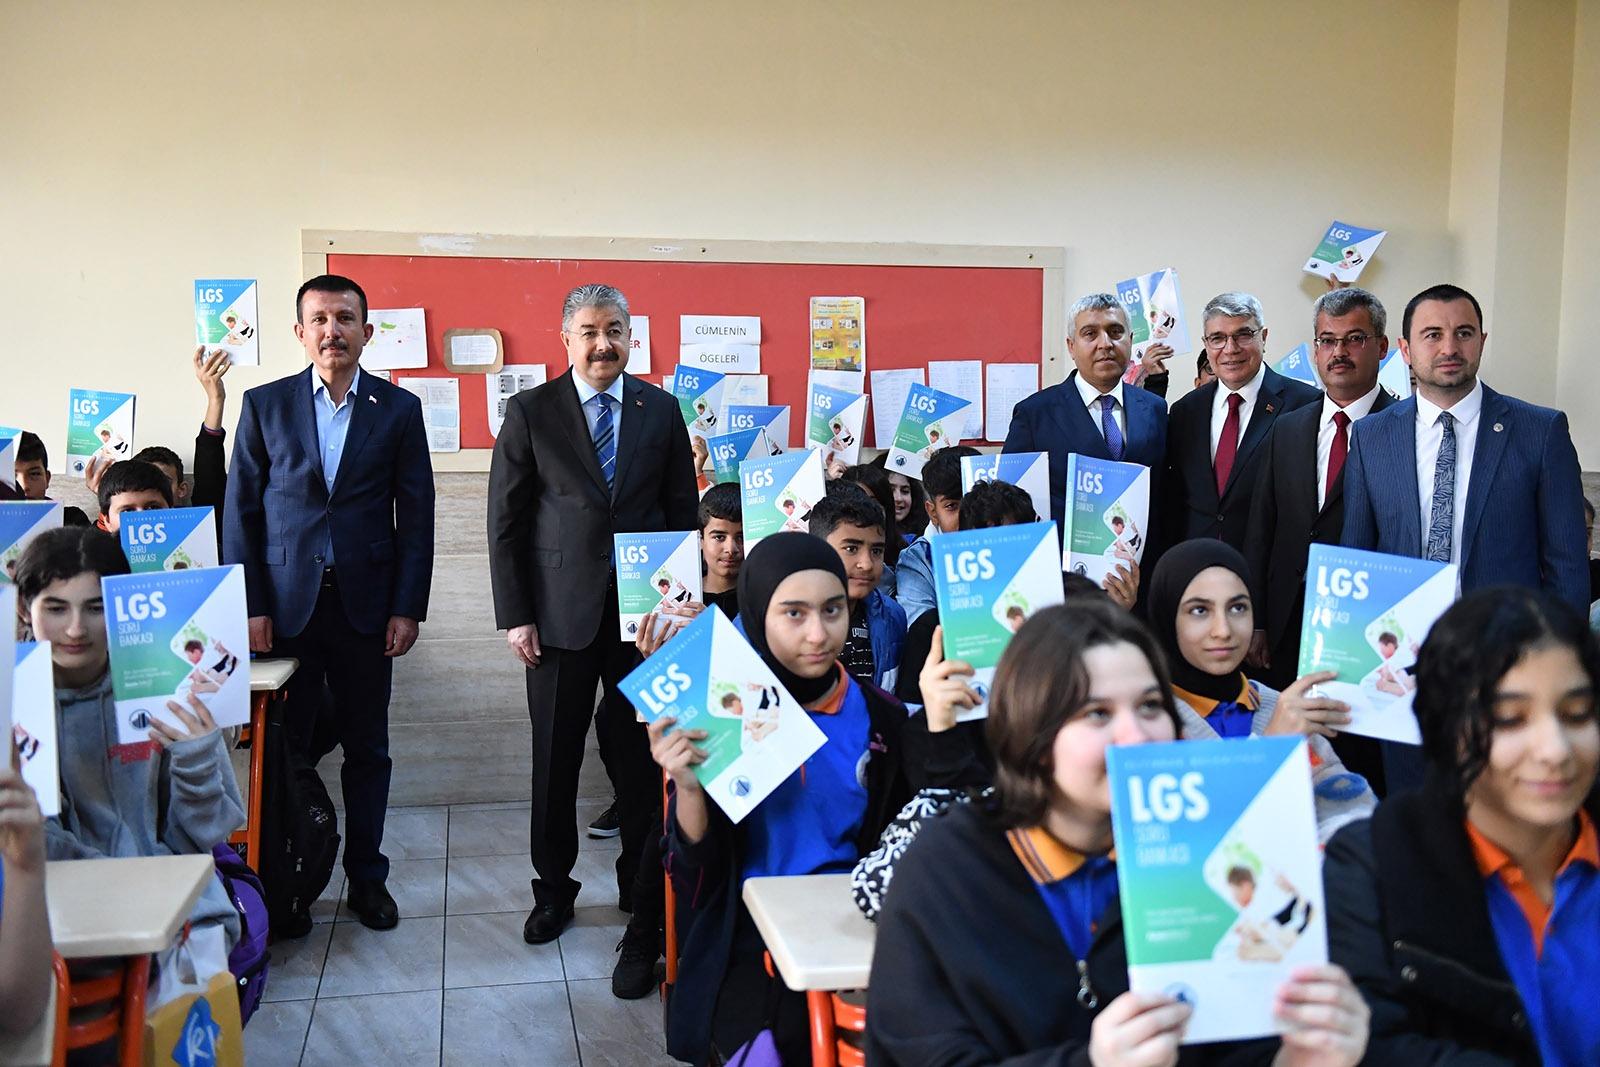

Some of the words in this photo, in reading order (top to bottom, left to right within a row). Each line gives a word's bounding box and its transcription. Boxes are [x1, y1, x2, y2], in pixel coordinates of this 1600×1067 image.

[1330, 227, 1352, 240] LGS
[199, 288, 224, 303] LGS
[695, 325, 747, 336] CÜMLENİN
[678, 373, 699, 389] LGS
[74, 398, 99, 416] LGS
[814, 393, 832, 409] LGS
[910, 393, 937, 413] LGS
[731, 415, 754, 428] LGS
[713, 443, 737, 461] LGS
[745, 468, 774, 489] LGS
[1077, 470, 1103, 494] LGS
[128, 523, 167, 545] LGS
[620, 545, 649, 564] LGS
[945, 550, 995, 583] LGS
[1317, 565, 1369, 600] LGS
[115, 591, 167, 622] LGS
[639, 663, 692, 714] LGS
[1128, 772, 1210, 823] LGS
